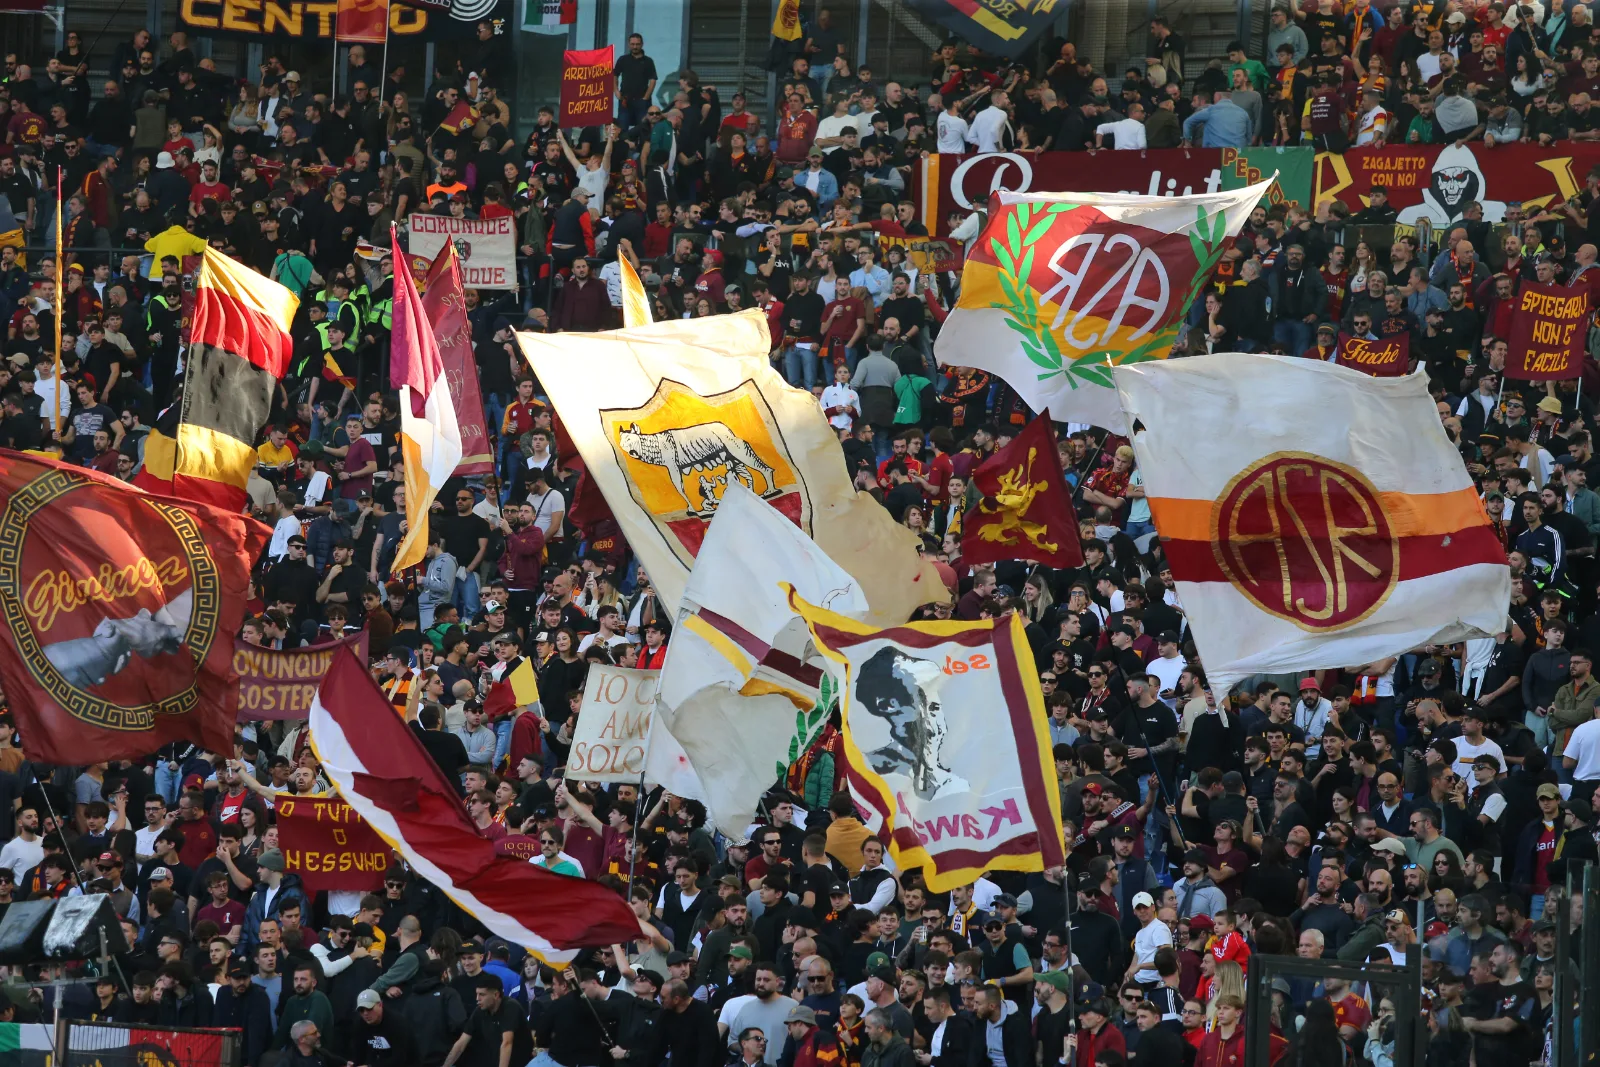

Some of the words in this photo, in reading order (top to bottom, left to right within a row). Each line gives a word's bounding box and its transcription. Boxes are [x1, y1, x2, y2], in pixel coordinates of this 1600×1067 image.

[181, 0, 428, 37] CENTO
[564, 61, 613, 81] ARRIVEREMO
[579, 83, 605, 97] DALLA
[568, 97, 609, 115] CAPITALE
[1362, 156, 1426, 170] ZAGAJETTO
[1371, 173, 1393, 186] CON
[1397, 173, 1416, 186] NOI
[412, 214, 510, 235] COMUNQUE
[1532, 320, 1561, 345] NON
[1342, 338, 1401, 365] Finchè
[1523, 349, 1571, 372] FACILE
[594, 673, 629, 705] IO
[635, 675, 660, 705] C
[571, 742, 645, 775] SOLO
[517, 843, 535, 851] CHE
[286, 849, 387, 872] NESSUNO
